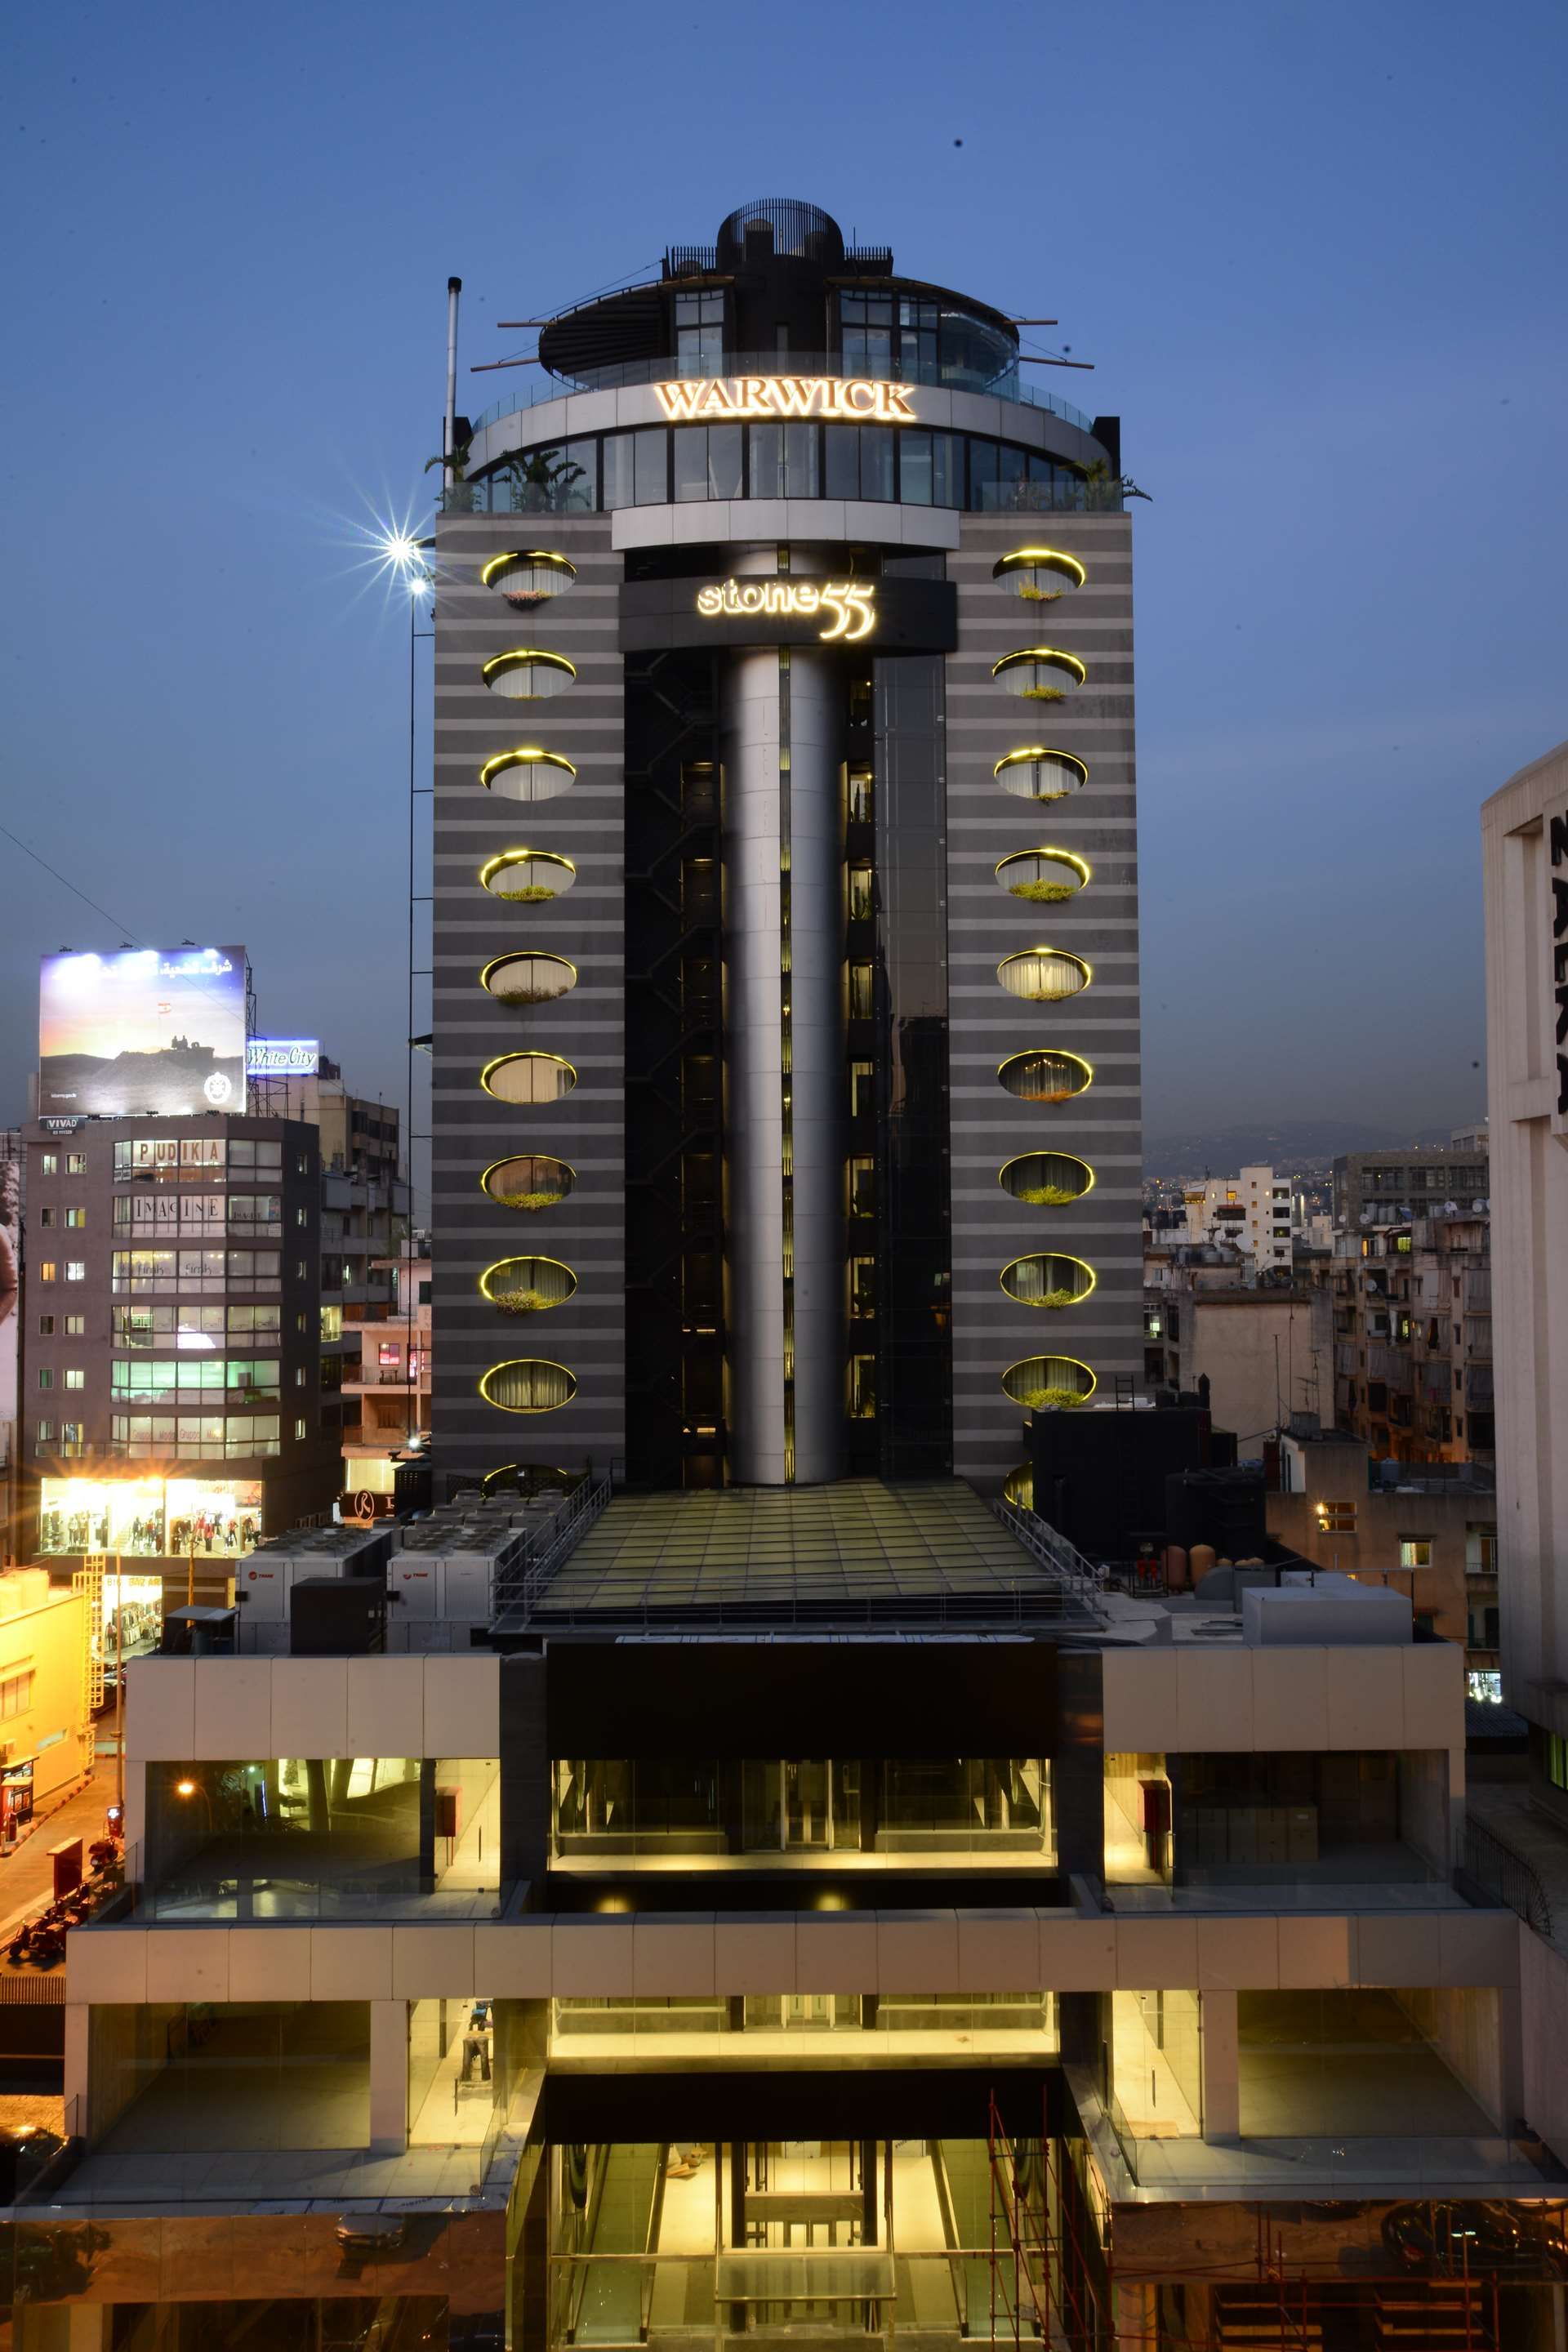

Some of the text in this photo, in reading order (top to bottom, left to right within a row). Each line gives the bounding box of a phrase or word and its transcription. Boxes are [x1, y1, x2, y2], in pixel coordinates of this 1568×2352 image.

[656, 379, 915, 420] WARWICK
[248, 1046, 315, 1067] White City
[140, 1143, 218, 1160] PUDIKA
[136, 1198, 218, 1218] IMAGINE
